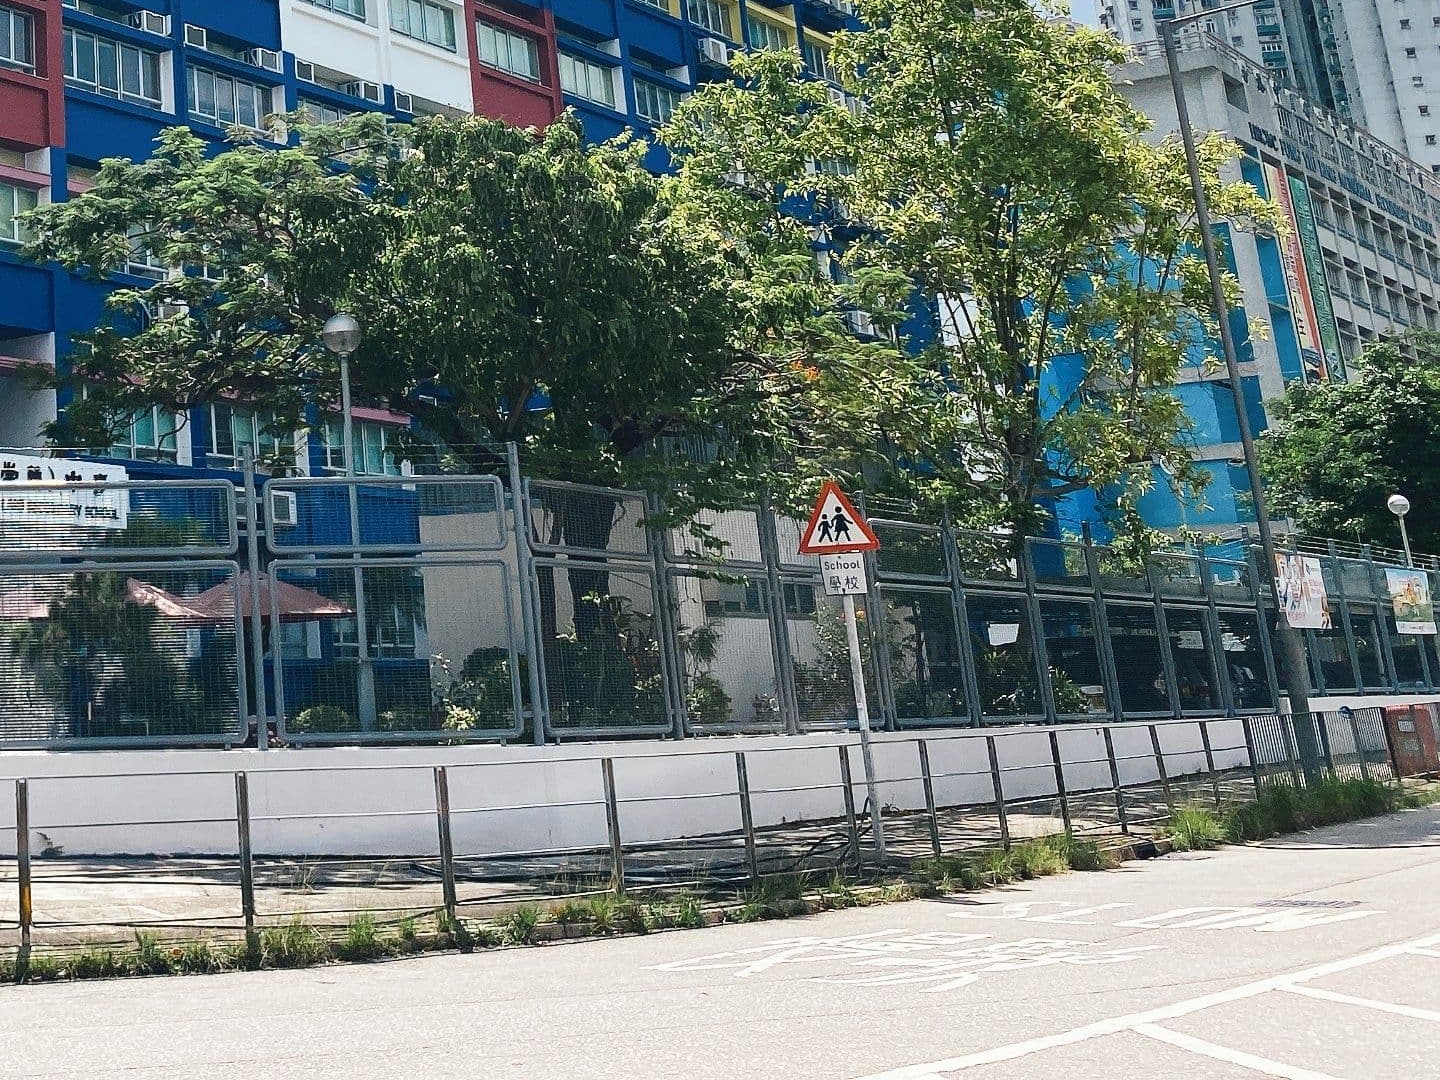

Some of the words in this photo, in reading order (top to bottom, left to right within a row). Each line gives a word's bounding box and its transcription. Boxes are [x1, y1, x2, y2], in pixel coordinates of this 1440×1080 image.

[824, 560, 861, 571] School
[829, 575, 860, 591] 學校
[945, 900, 1387, 933] SLOW
